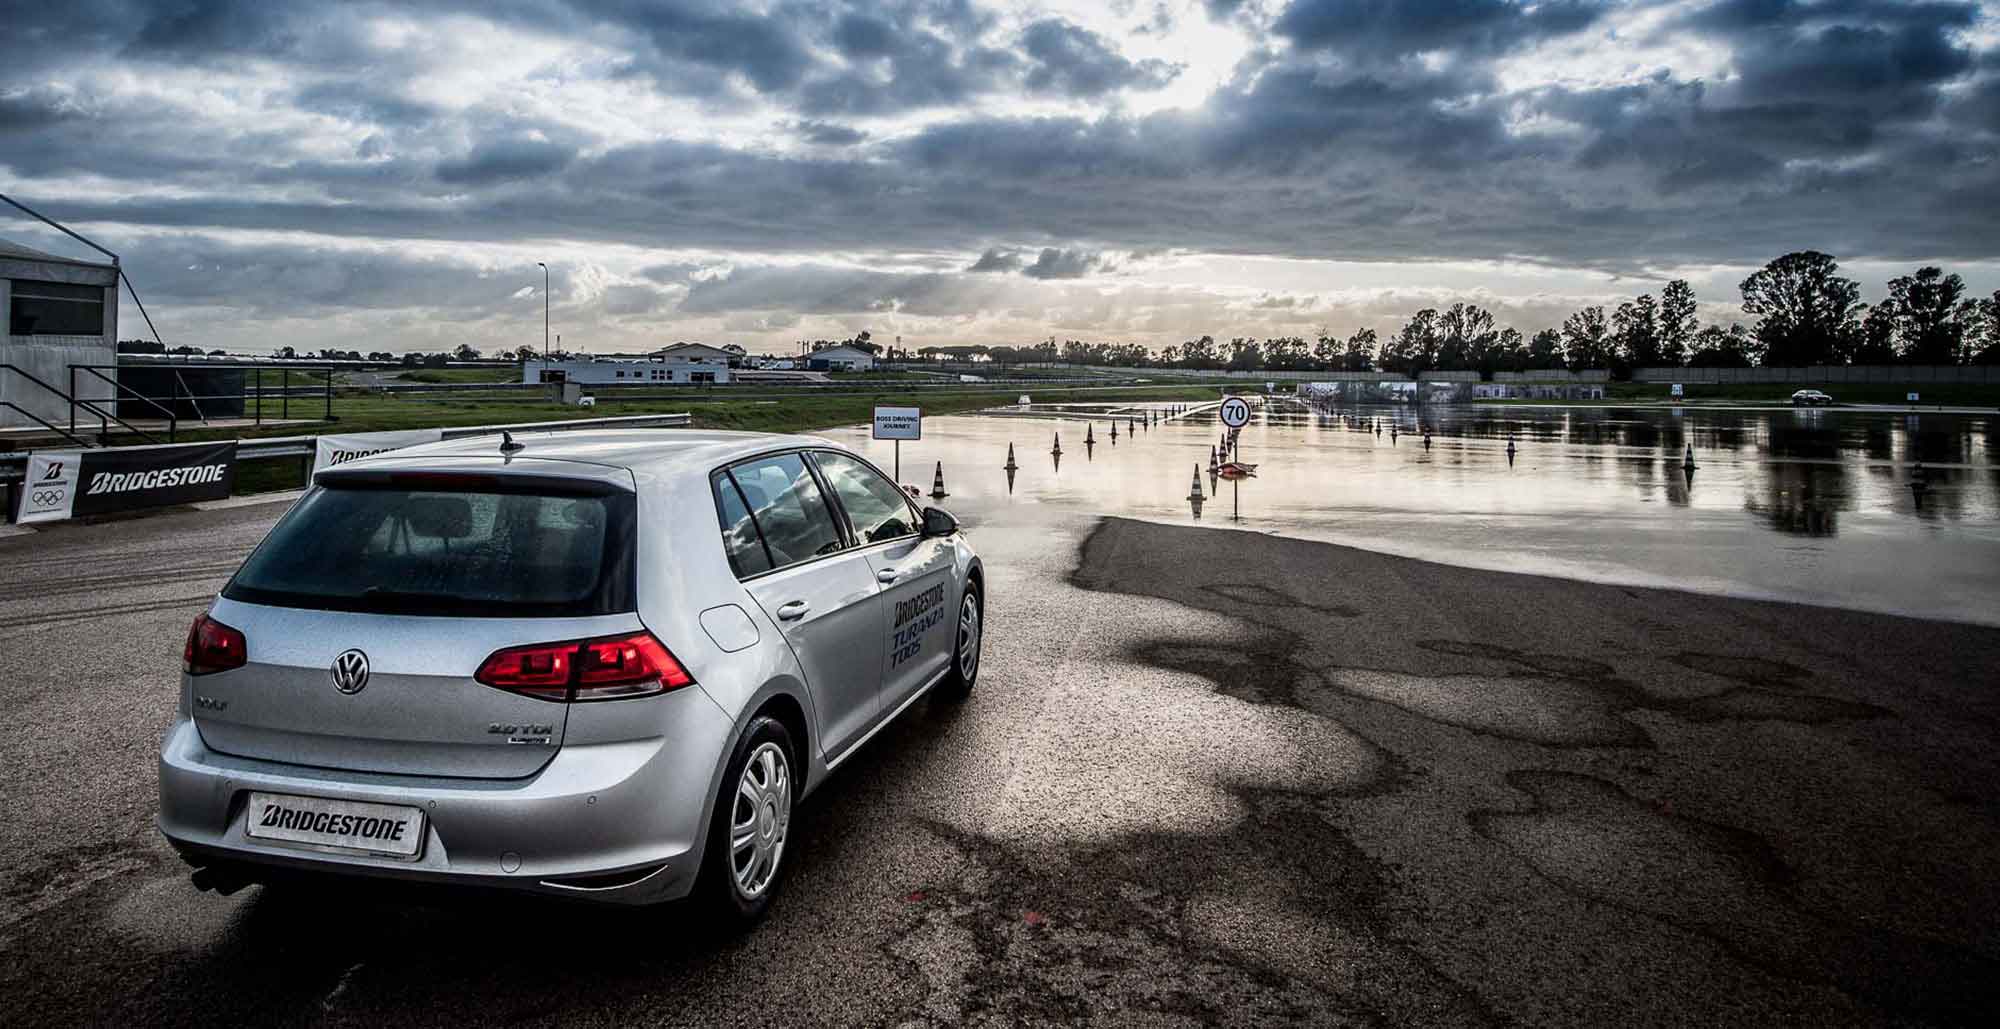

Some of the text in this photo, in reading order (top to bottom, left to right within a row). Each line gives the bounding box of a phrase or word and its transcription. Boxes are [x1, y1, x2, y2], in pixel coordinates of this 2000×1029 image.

[1226, 405, 1245, 420] 70
[87, 463, 227, 495] BRIDGESTONE
[894, 581, 945, 628] BRIDGESTONE
[892, 605, 945, 650] TURANZA
[260, 804, 407, 841] BRIDGESTONE
